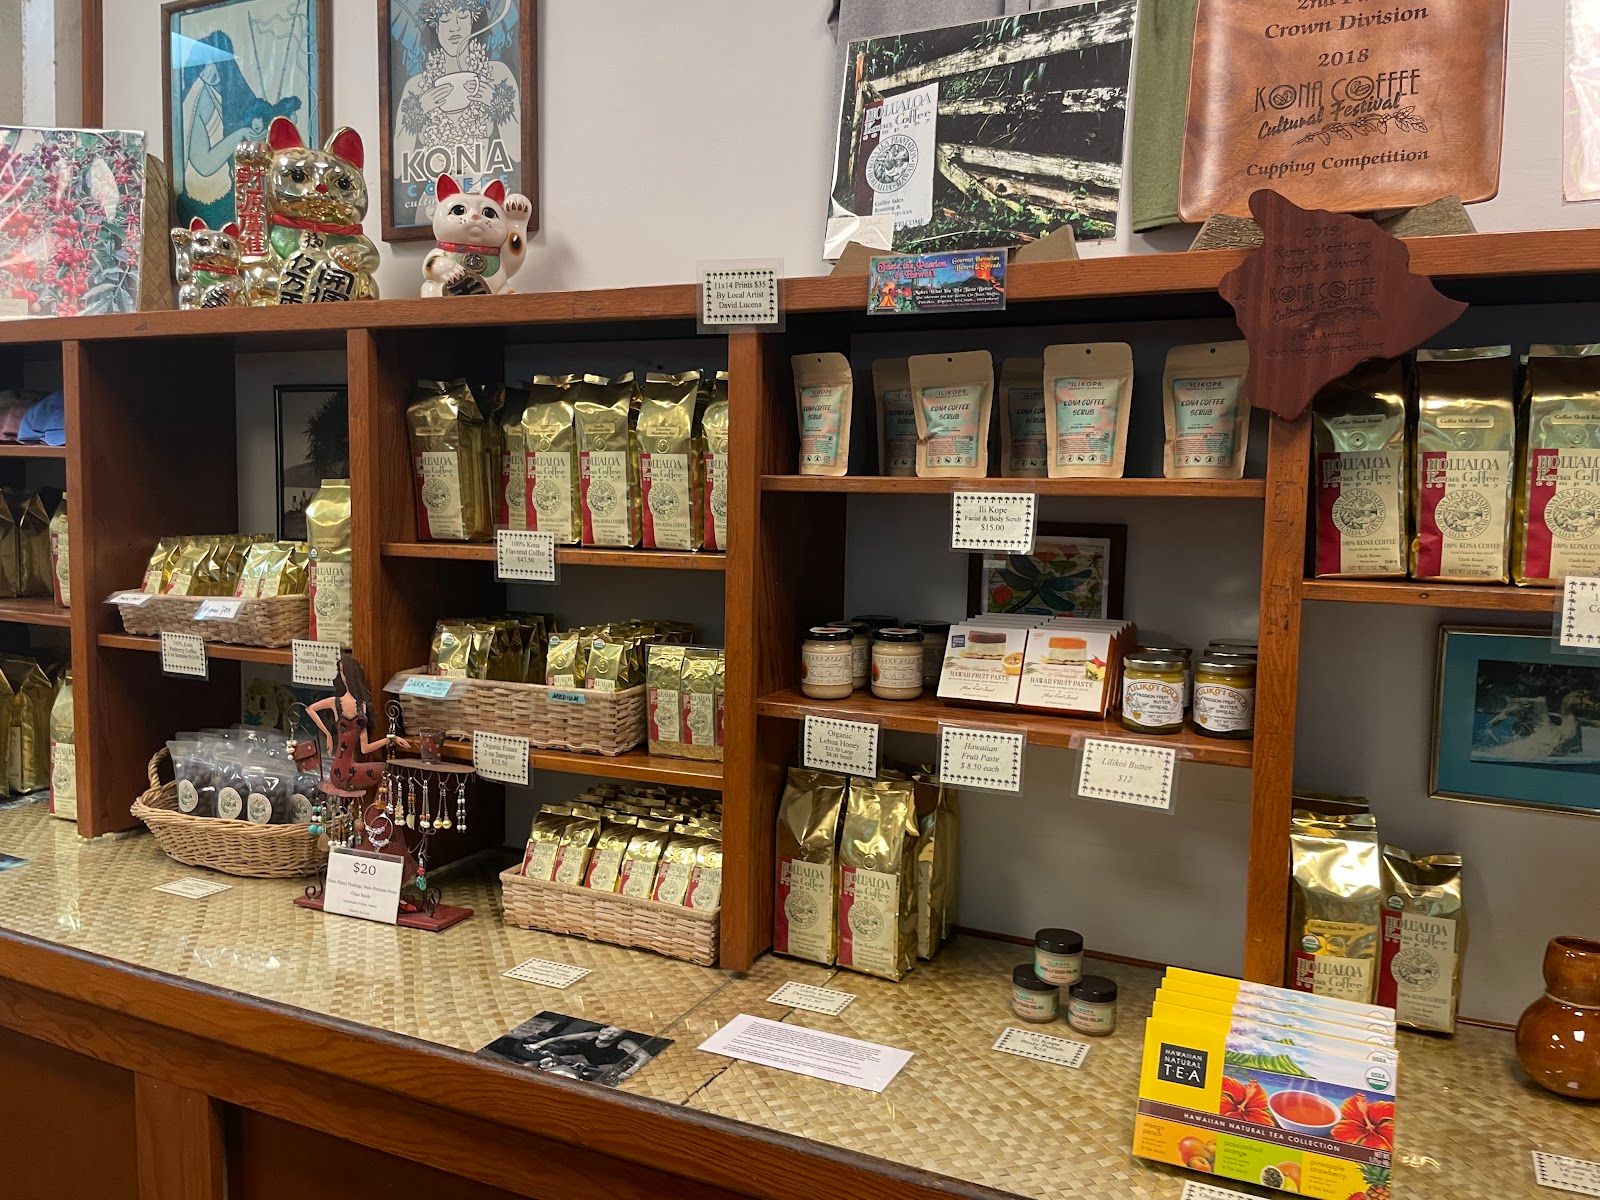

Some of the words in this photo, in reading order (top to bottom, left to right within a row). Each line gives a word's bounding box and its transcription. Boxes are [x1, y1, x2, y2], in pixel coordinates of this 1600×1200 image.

[1264, 21, 1332, 40] Crown
[1336, 6, 1431, 31] Division
[1317, 47, 1370, 68] 2018
[1253, 81, 1324, 113] KONA
[1331, 69, 1421, 102] COFFEE
[1256, 104, 1325, 141] Cultural
[1331, 91, 1402, 122] Festival
[402, 138, 514, 184] KONA
[1246, 159, 1316, 180] Cupping
[1321, 148, 1431, 175] Competition
[716, 292, 726, 301] By
[727, 291, 745, 299] Local
[948, 404, 971, 412] COFFEE
[1064, 398, 1082, 407] KONA
[1082, 398, 1107, 406] COFFEE
[1199, 398, 1225, 406] COFFEE
[939, 412, 960, 420] SCRUB
[1427, 458, 1500, 472] HOLUALOA
[1356, 468, 1391, 482] Coffee
[1463, 470, 1500, 484] Coffee
[988, 506, 1008, 514] Kope
[980, 524, 1004, 532] $15.00
[950, 671, 970, 679] HAWAII
[990, 674, 1010, 682] PASTE
[1030, 676, 1052, 684] HAWAII
[1073, 680, 1094, 688] PASTE
[551, 692, 580, 702] MEDIUM
[828, 730, 852, 740] Organic
[820, 736, 838, 746] Lehua
[840, 740, 860, 750] Honey
[964, 742, 998, 752] Hawaiian
[962, 752, 979, 760] Fruit
[980, 754, 1000, 762] Paste
[1101, 758, 1127, 768] Lilikoi
[1128, 761, 1153, 771] Butter
[1118, 774, 1133, 783] $12
[352, 862, 376, 876] $20
[1416, 933, 1448, 946] Coffee
[1328, 976, 1362, 988] Coffee
[1166, 1048, 1203, 1060] HAWAIIAN
[1164, 1056, 1202, 1069] NATURAL
[1184, 1112, 1226, 1128] HAWAIIAN
[1228, 1124, 1266, 1138] NATURAL
[1269, 1132, 1284, 1141] TEA
[1287, 1135, 1340, 1152] COLLECTION
[1310, 1160, 1346, 1172] pineapple
[1308, 1166, 1347, 1181] strawberry
